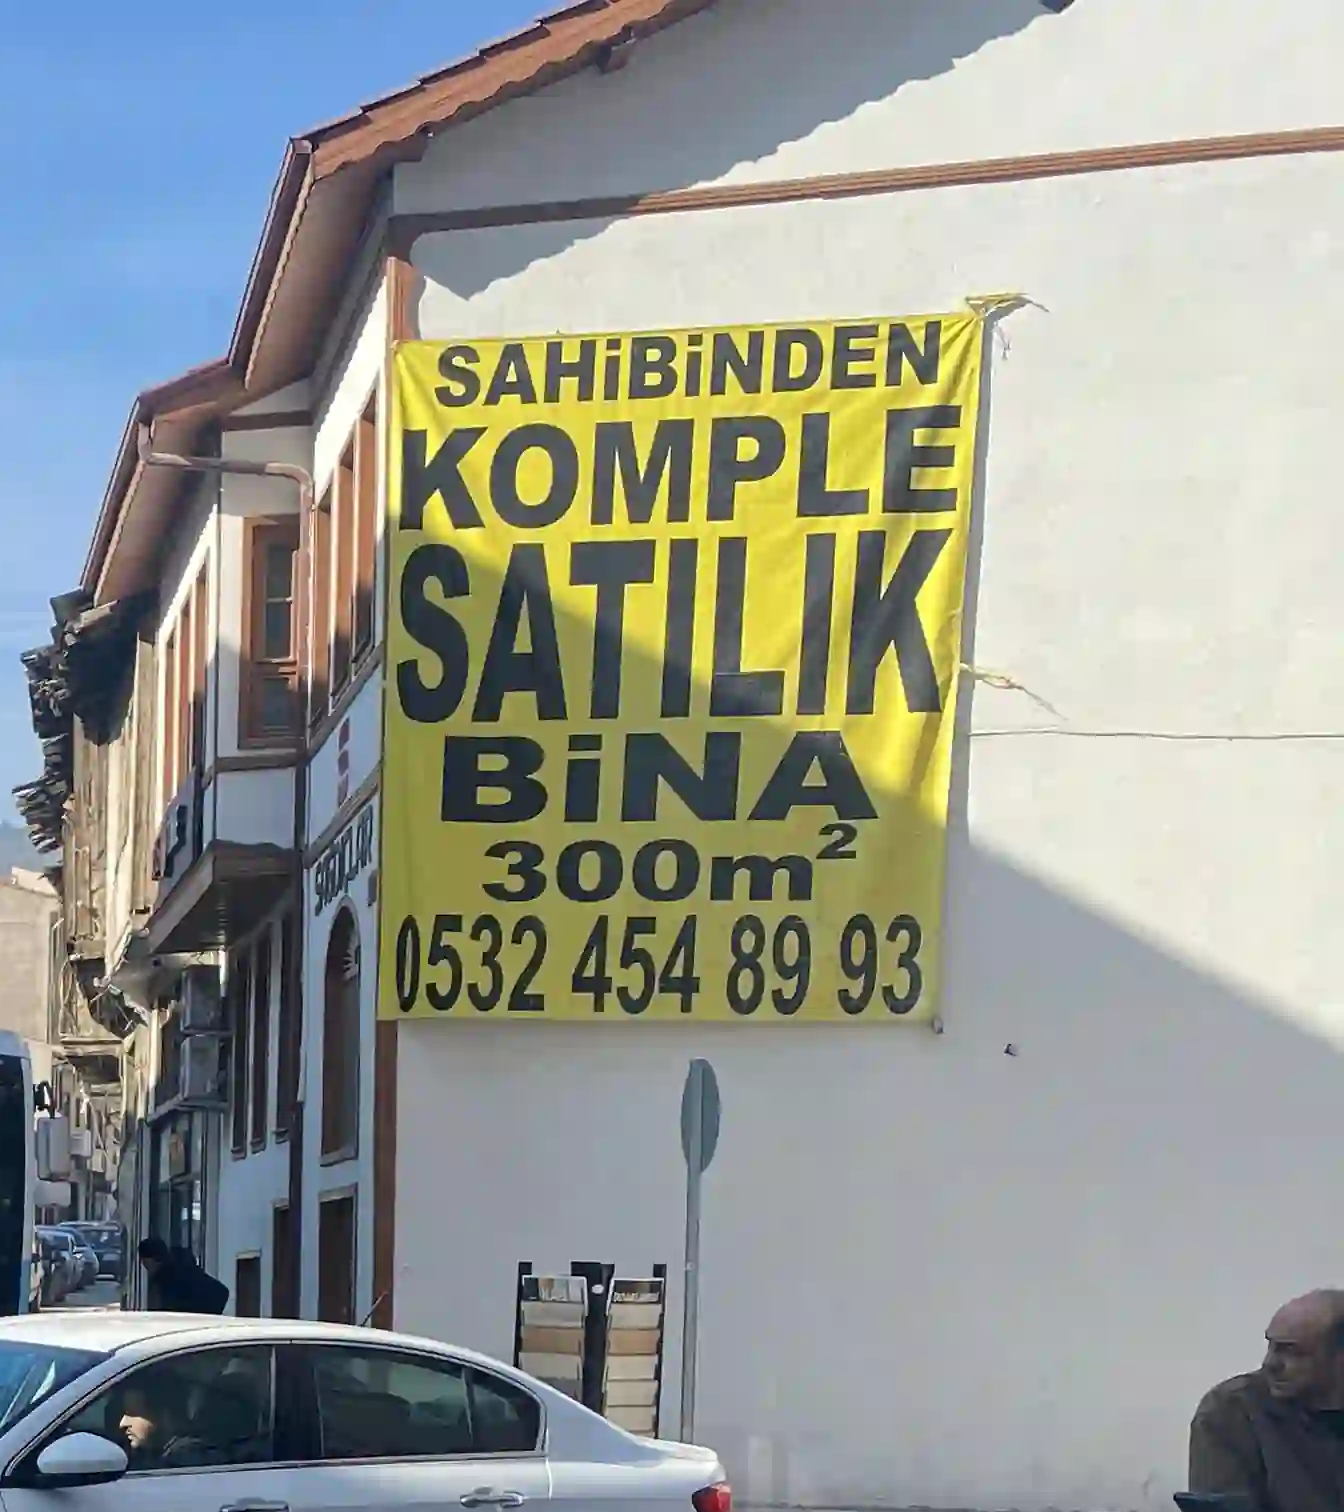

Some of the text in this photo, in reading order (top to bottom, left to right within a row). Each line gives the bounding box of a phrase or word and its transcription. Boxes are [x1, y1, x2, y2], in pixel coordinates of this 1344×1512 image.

[399, 404, 963, 531] KOMPLE
[396, 527, 953, 723] SATILIK
[395, 914, 923, 1016] 0532 454 89 93
